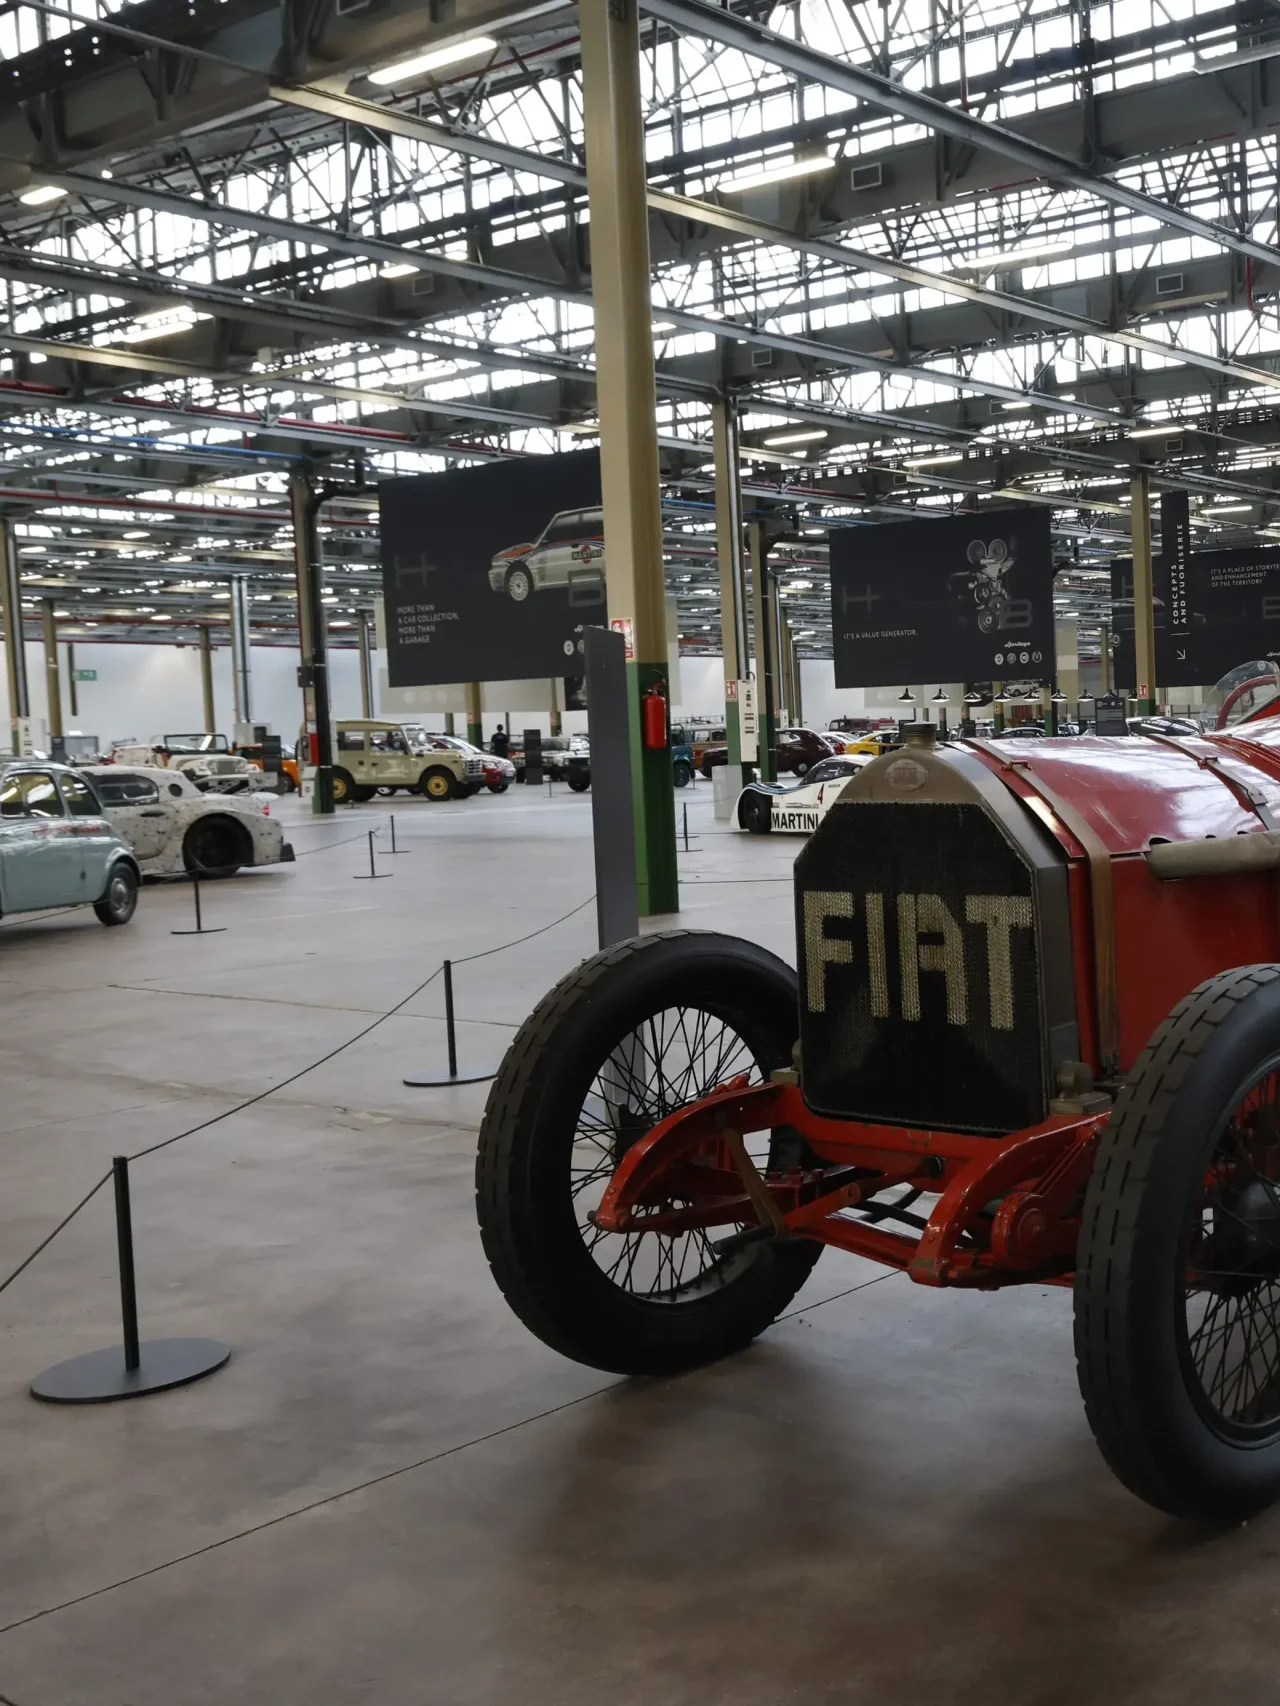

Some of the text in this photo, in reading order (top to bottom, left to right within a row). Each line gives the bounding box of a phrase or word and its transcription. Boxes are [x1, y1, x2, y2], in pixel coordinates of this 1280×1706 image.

[1177, 524, 1186, 595] FUORISERIE
[1224, 571, 1267, 579] ENHANCEMENT
[1171, 564, 1179, 625] CONCEPTS
[861, 631, 880, 639] VALUE
[817, 783, 825, 804] 4
[772, 813, 819, 829] MARTINI
[803, 891, 1033, 1030] FIAT
